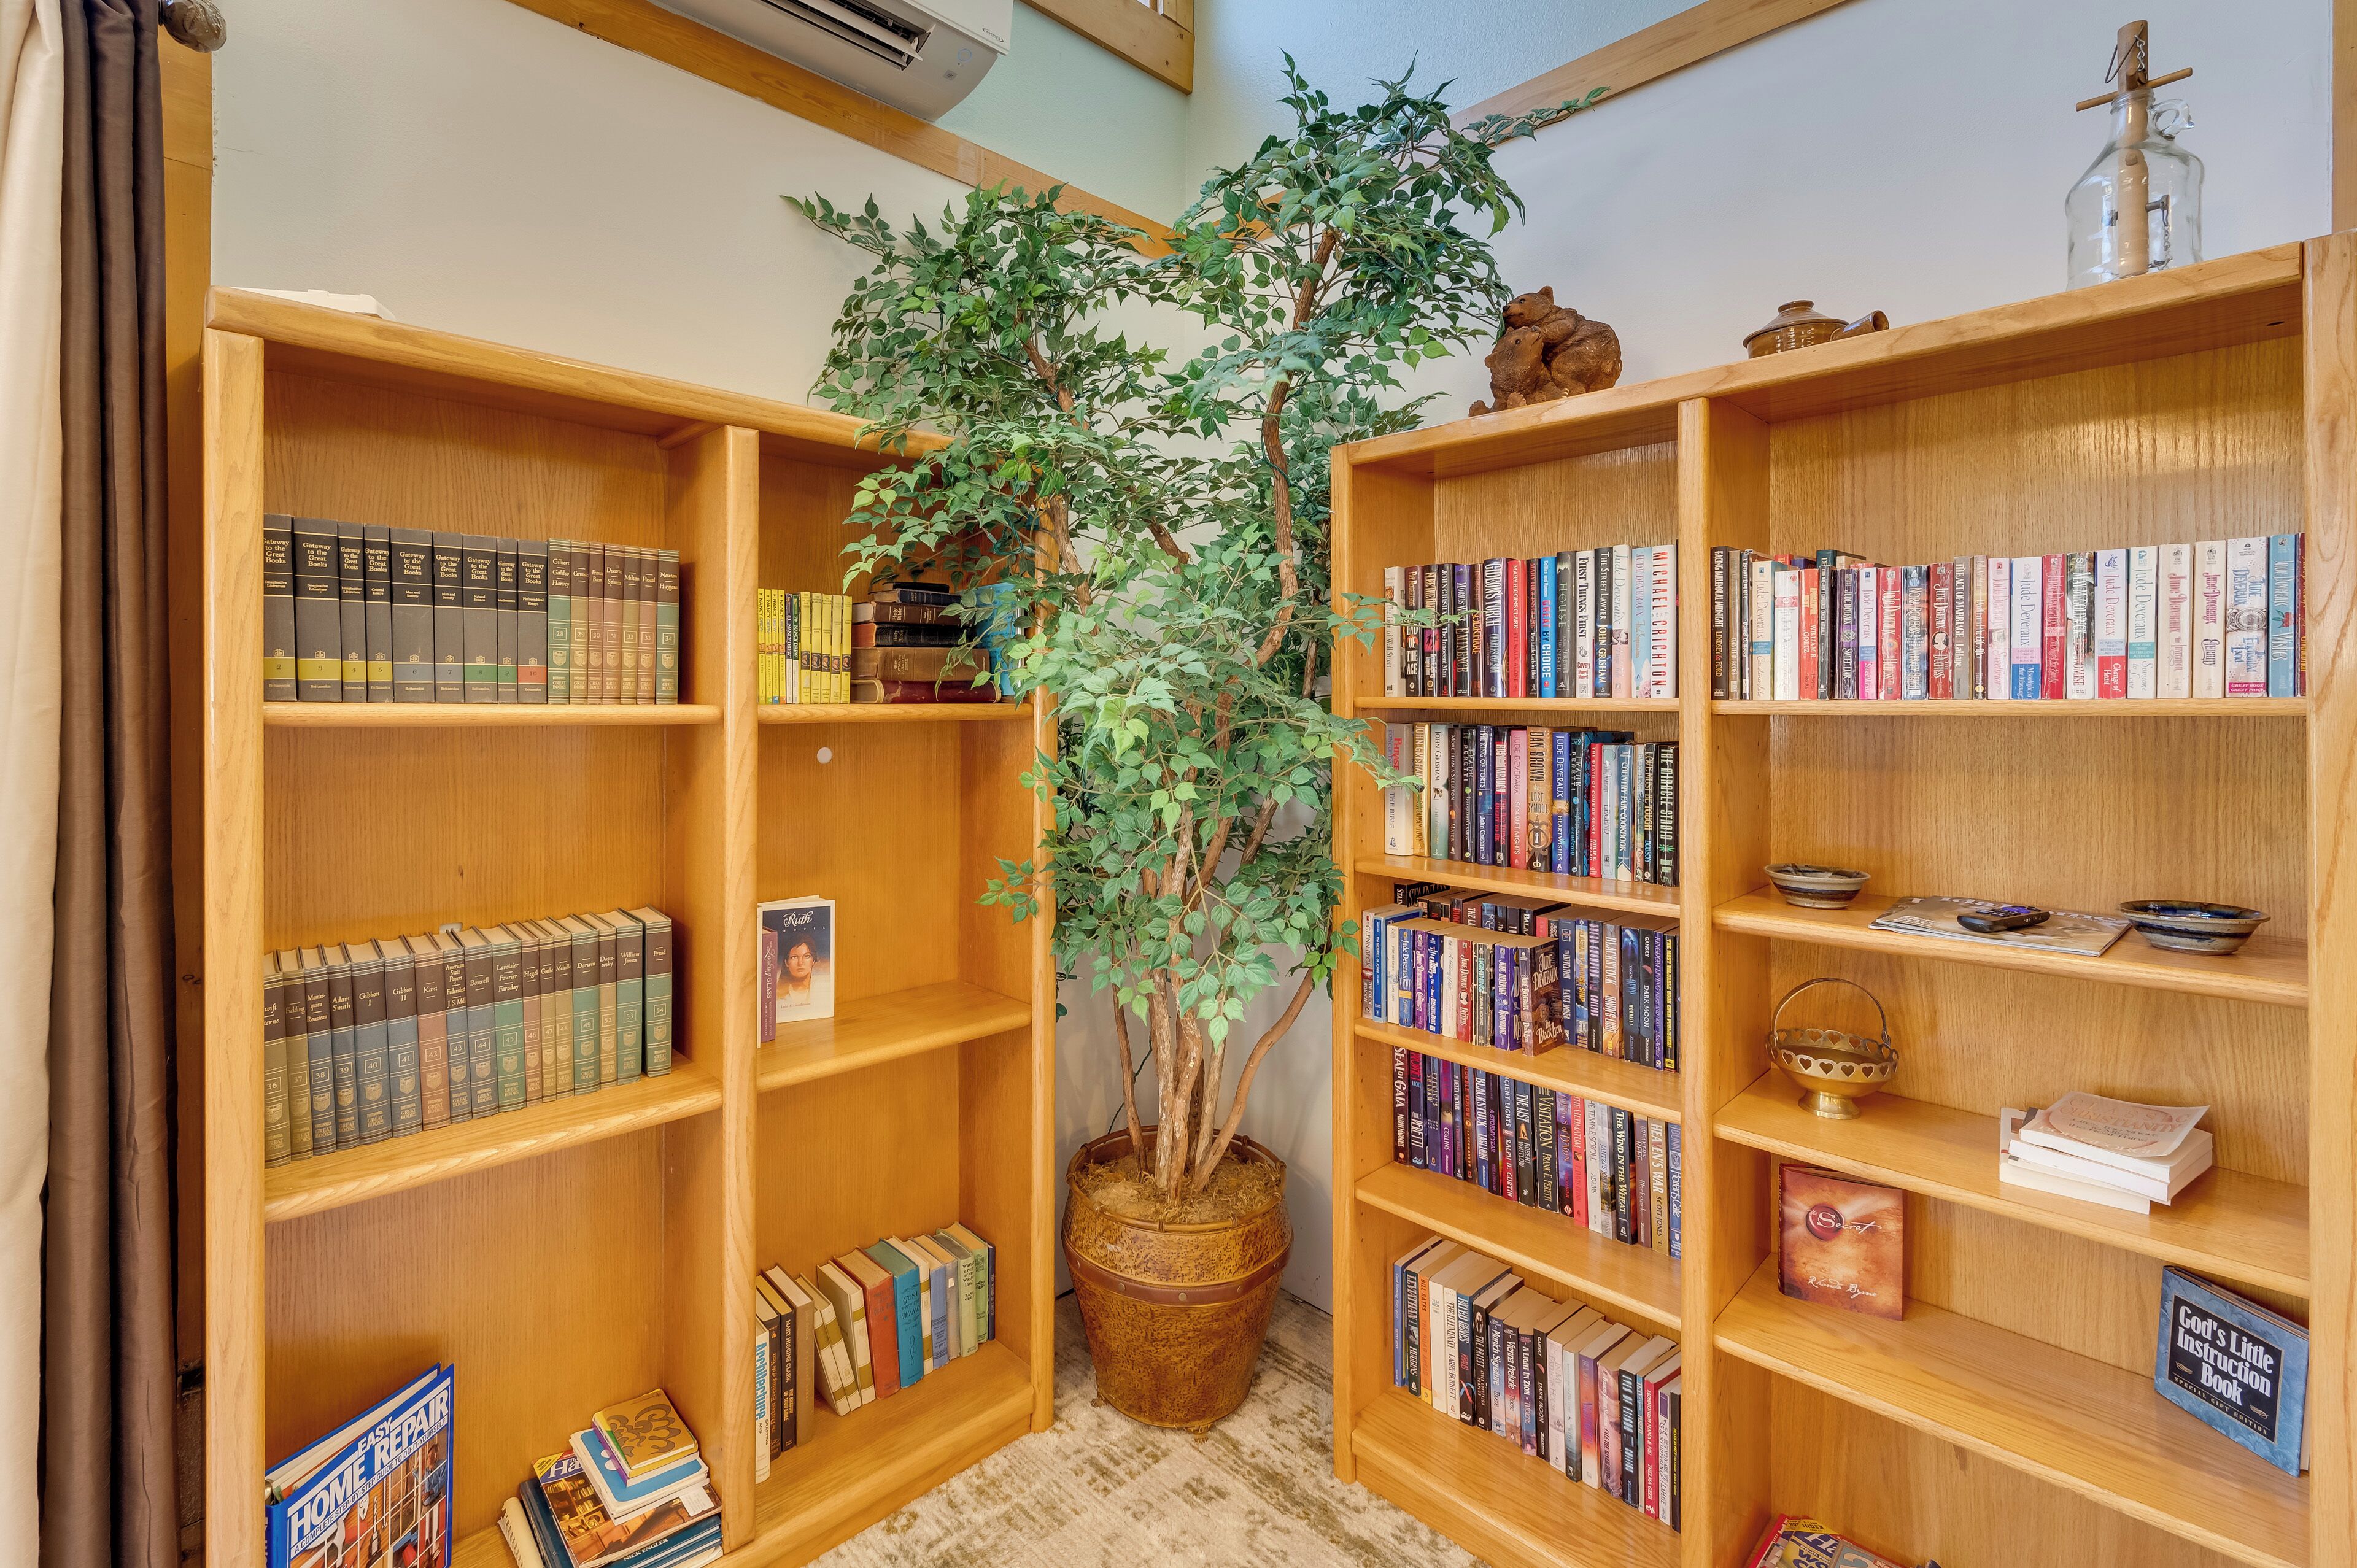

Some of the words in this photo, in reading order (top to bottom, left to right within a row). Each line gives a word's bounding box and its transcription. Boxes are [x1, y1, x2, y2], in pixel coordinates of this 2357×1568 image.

[986, 31, 1000, 40] INVERTER
[1578, 557, 1589, 581] FIRST
[1601, 551, 1609, 568] THE
[1600, 568, 1609, 592] STREET
[1652, 551, 1668, 610] MICHAEL
[2102, 575, 2119, 593] Jude
[2135, 568, 2152, 590] Jude
[1558, 583, 1567, 628] HOUSE
[1578, 582, 1589, 616] THINGS
[1600, 593, 1609, 620] LAWYER
[1909, 587, 1922, 607] NORA
[1485, 599, 1501, 627] TORCH
[1542, 600, 1550, 628] GREAT
[1905, 607, 1921, 635] ROBERTS
[2105, 597, 2119, 636] Deveraux
[2134, 594, 2152, 639] Deveraux
[1542, 631, 1550, 641] BY
[1578, 616, 1587, 639] FIRST
[1596, 624, 1607, 646] JOHN
[1456, 627, 1468, 673] EMINENCE
[1542, 643, 1551, 678] CHOICE
[1652, 620, 1668, 686] CRICHTON
[1598, 649, 1607, 683] GRISHAM
[2111, 663, 2122, 684] Change
[1530, 732, 1545, 748] DAN
[1555, 736, 1564, 755] JUDE
[1530, 751, 1545, 782] BROWN
[1531, 792, 1544, 801] LOST
[1528, 804, 1548, 814] SYMBOL
[783, 911, 813, 928] Ruth
[497, 962, 519, 971] Lavoisier
[764, 947, 773, 978] Looking
[1605, 937, 1617, 986] BLACKSTOCK
[393, 987, 412, 995] Gibbon
[449, 975, 462, 983] Papers
[470, 977, 489, 986] Boswell
[359, 992, 379, 1000] Gibbon
[1394, 1080, 1406, 1108] GAIA
[1517, 1094, 1529, 1107] THE
[1517, 1106, 1530, 1123] LIST
[1539, 1095, 1554, 1149] VISITATION
[1616, 1112, 1625, 1129] THE
[1411, 1118, 1423, 1148] PERETTI
[1616, 1129, 1625, 1153] WIND
[1652, 1169, 1664, 1194] WAR
[1817, 1212, 1882, 1234] Secret
[903, 1291, 919, 1304] GONE
[1808, 1276, 1841, 1290] Rhonda
[1846, 1283, 1877, 1299] Byrne
[901, 1305, 919, 1319] WIND
[1492, 1329, 1500, 1353] Munich
[2179, 1305, 2226, 1347] God's
[2229, 1330, 2274, 1374] Little
[1476, 1349, 1485, 1369] PRIEST
[1507, 1341, 1516, 1364] Vienna
[2177, 1326, 2270, 1397] Instruction
[1491, 1354, 1501, 1386] Signature
[1507, 1363, 1516, 1390] Prelude
[2200, 1362, 2243, 1406] Book
[2174, 1377, 2206, 1399] SPECIAL
[2211, 1398, 2229, 1412] GIFT
[2234, 1412, 2267, 1435] EDITION
[357, 1416, 393, 1456] EASY
[291, 1454, 366, 1546] HOME
[374, 1389, 448, 1474] REPAIR
[301, 1515, 334, 1547] COMPLETE
[335, 1477, 375, 1518] STEP-BY-STEP
[377, 1464, 393, 1480] GUIDE
[395, 1455, 401, 1464] TO
[403, 1418, 446, 1459] DO-IT-YOURSELF
[624, 1549, 642, 1562] NICK
[642, 1538, 668, 1553] ENGLER
